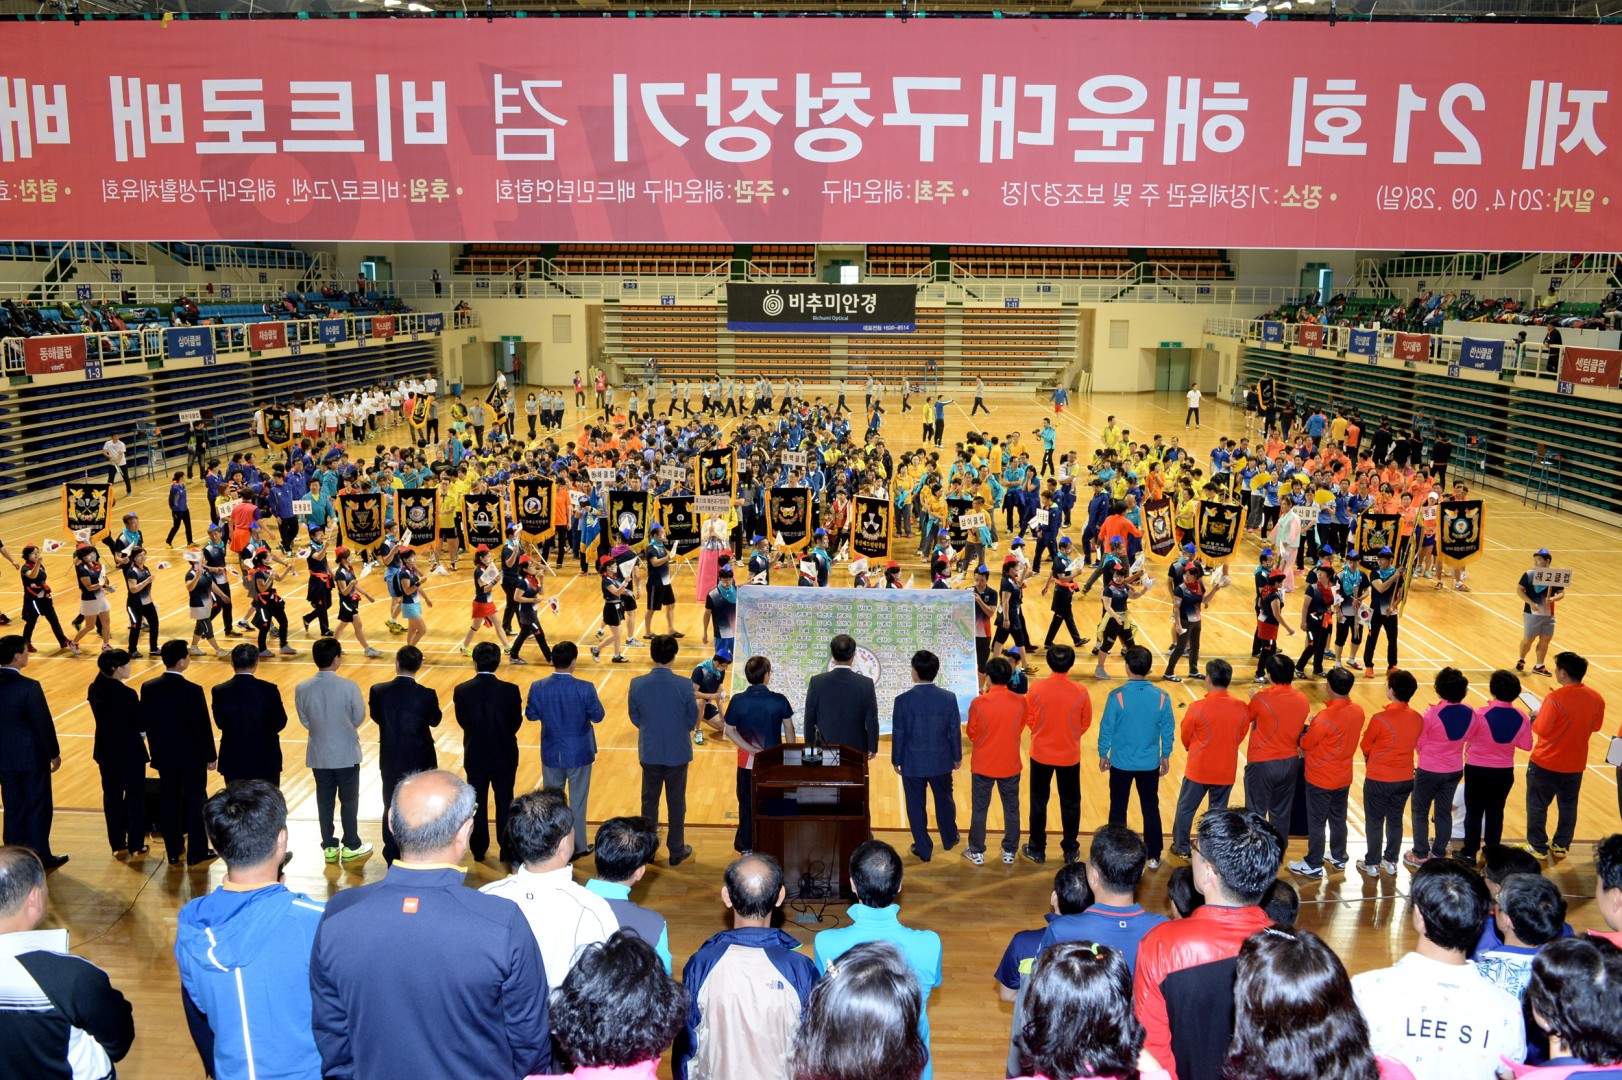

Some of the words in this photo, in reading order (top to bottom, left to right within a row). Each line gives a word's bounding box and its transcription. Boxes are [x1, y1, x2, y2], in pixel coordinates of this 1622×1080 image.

[79, 291, 91, 300] 2-4
[788, 292, 877, 314] 비추미안경
[40, 345, 75, 362] 동해클럽
[205, 356, 214, 364] 1-4
[1575, 357, 1607, 374] 센텀클럽
[88, 369, 101, 379] 1-3
[1560, 383, 1572, 394] 1-16
[1406, 1017, 1448, 1040] LEE
